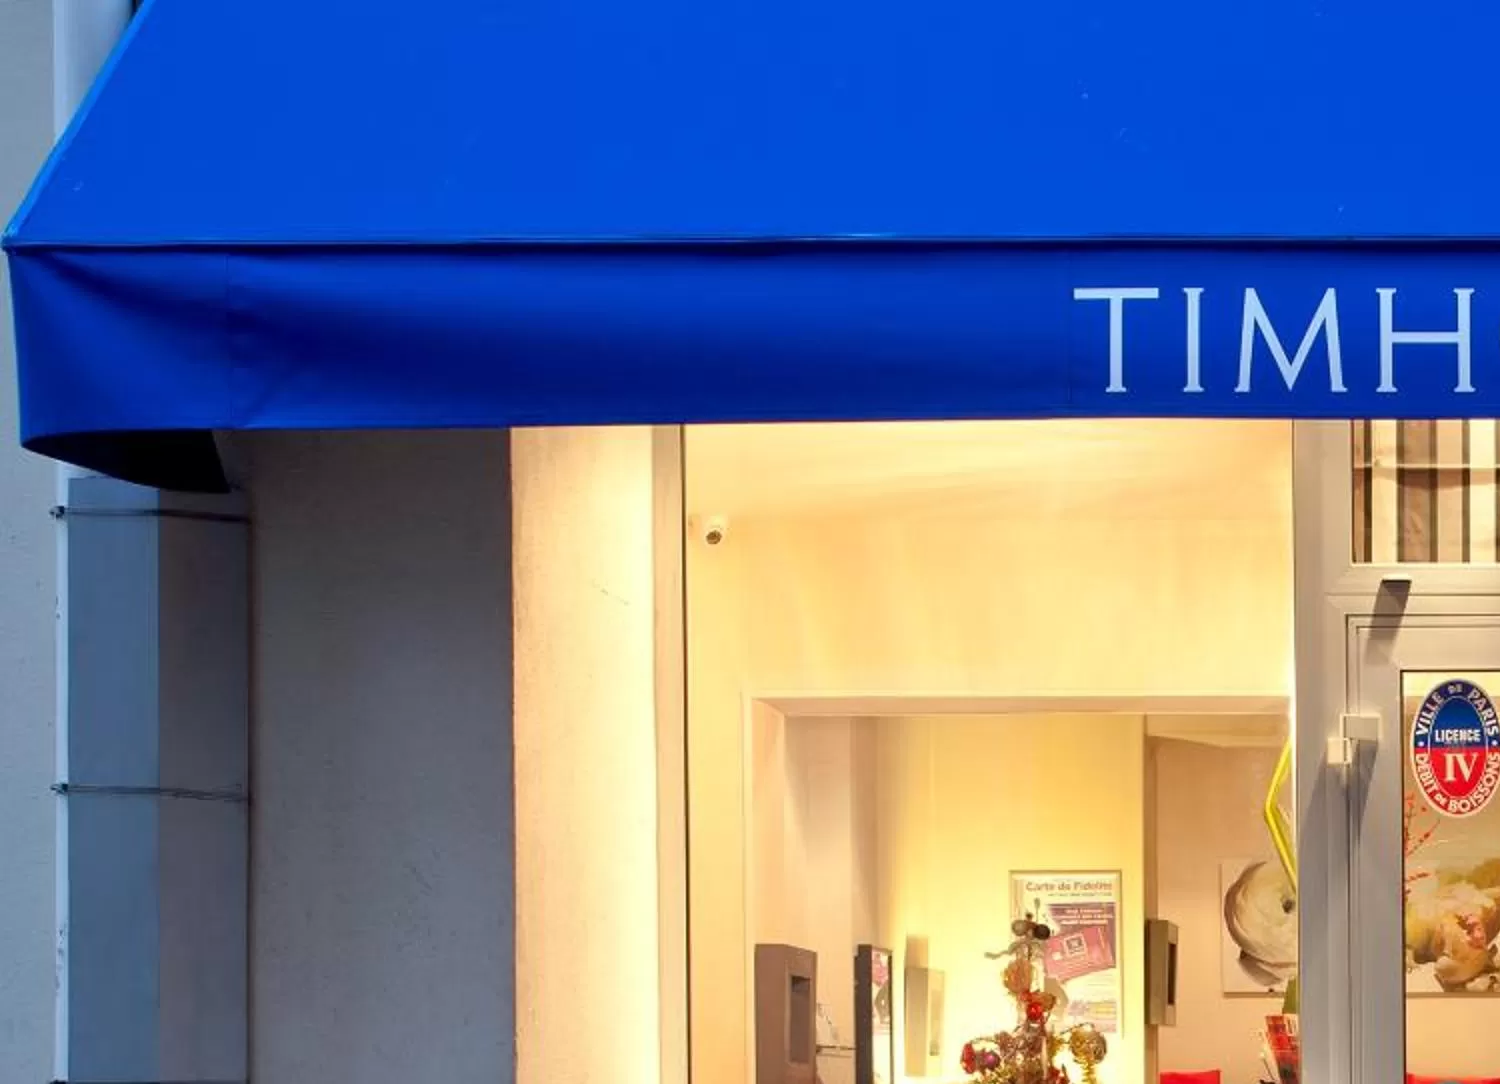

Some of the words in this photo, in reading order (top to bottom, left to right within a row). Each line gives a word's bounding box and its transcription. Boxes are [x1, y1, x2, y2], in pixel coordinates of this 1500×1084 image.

[1416, 692, 1443, 736] VILLE
[1468, 689, 1499, 736] PARIS
[1434, 729, 1481, 742] LICENCE
[1442, 753, 1480, 782] IV
[1448, 753, 1500, 812] BOISSONS
